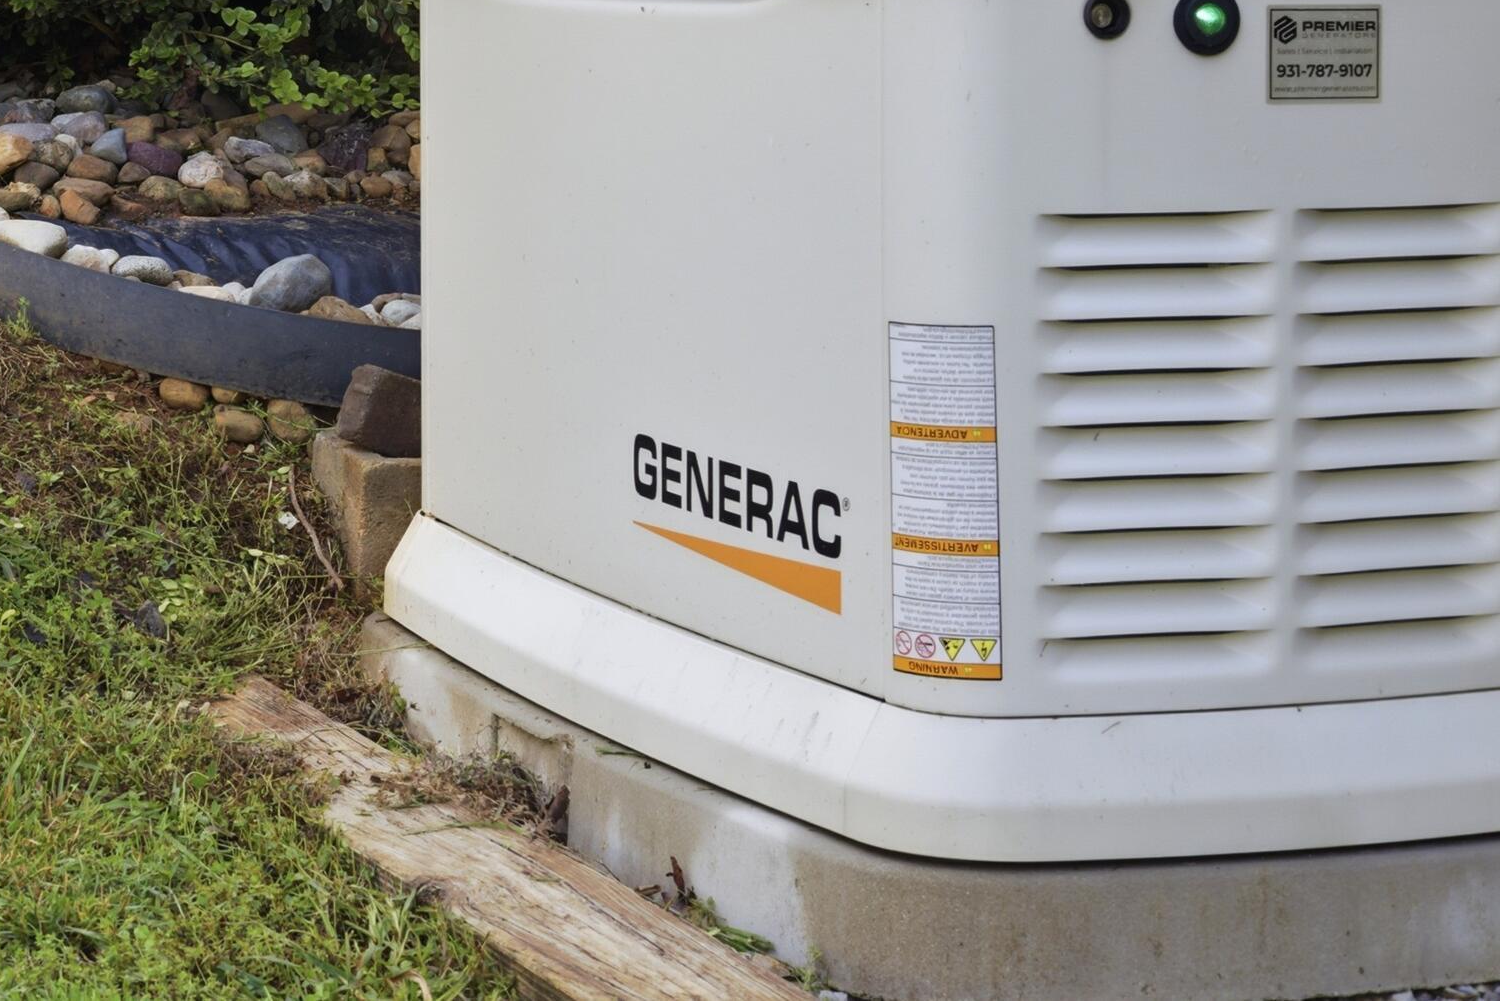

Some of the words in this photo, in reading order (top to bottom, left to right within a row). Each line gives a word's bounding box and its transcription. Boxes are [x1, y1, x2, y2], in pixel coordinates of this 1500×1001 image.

[1302, 21, 1376, 32] PREMIER
[1276, 63, 1373, 78] 931-787-9107
[633, 433, 842, 559] GENERAC
[894, 537, 979, 552] AVERTISSEMENT
[908, 661, 959, 675] WARNING
